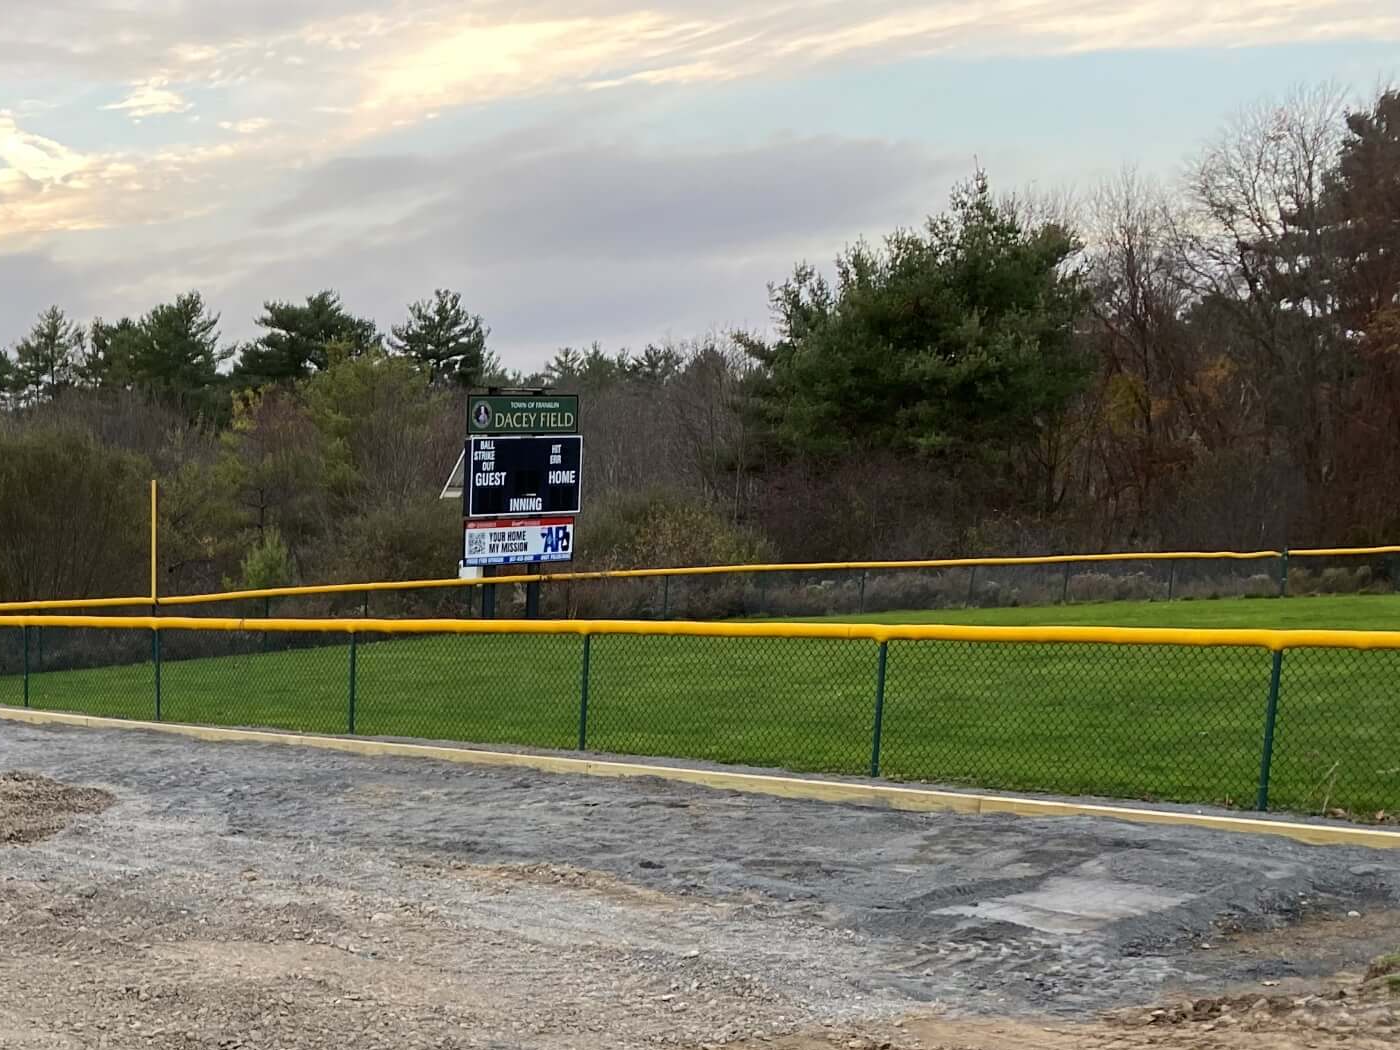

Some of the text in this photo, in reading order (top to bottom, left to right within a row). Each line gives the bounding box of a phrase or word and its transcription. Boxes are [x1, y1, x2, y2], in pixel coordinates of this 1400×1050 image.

[495, 412, 574, 428] DACEY FIELD
[480, 440, 495, 450] BALL
[551, 444, 562, 454] HIT
[473, 450, 495, 461] STRIKE
[482, 461, 495, 471] OUT
[475, 472, 507, 487] GUEST
[548, 470, 576, 485] HOME
[509, 497, 542, 512] INNING
[489, 530, 527, 543] YOUR HOME
[489, 541, 528, 553] MY MISSION
